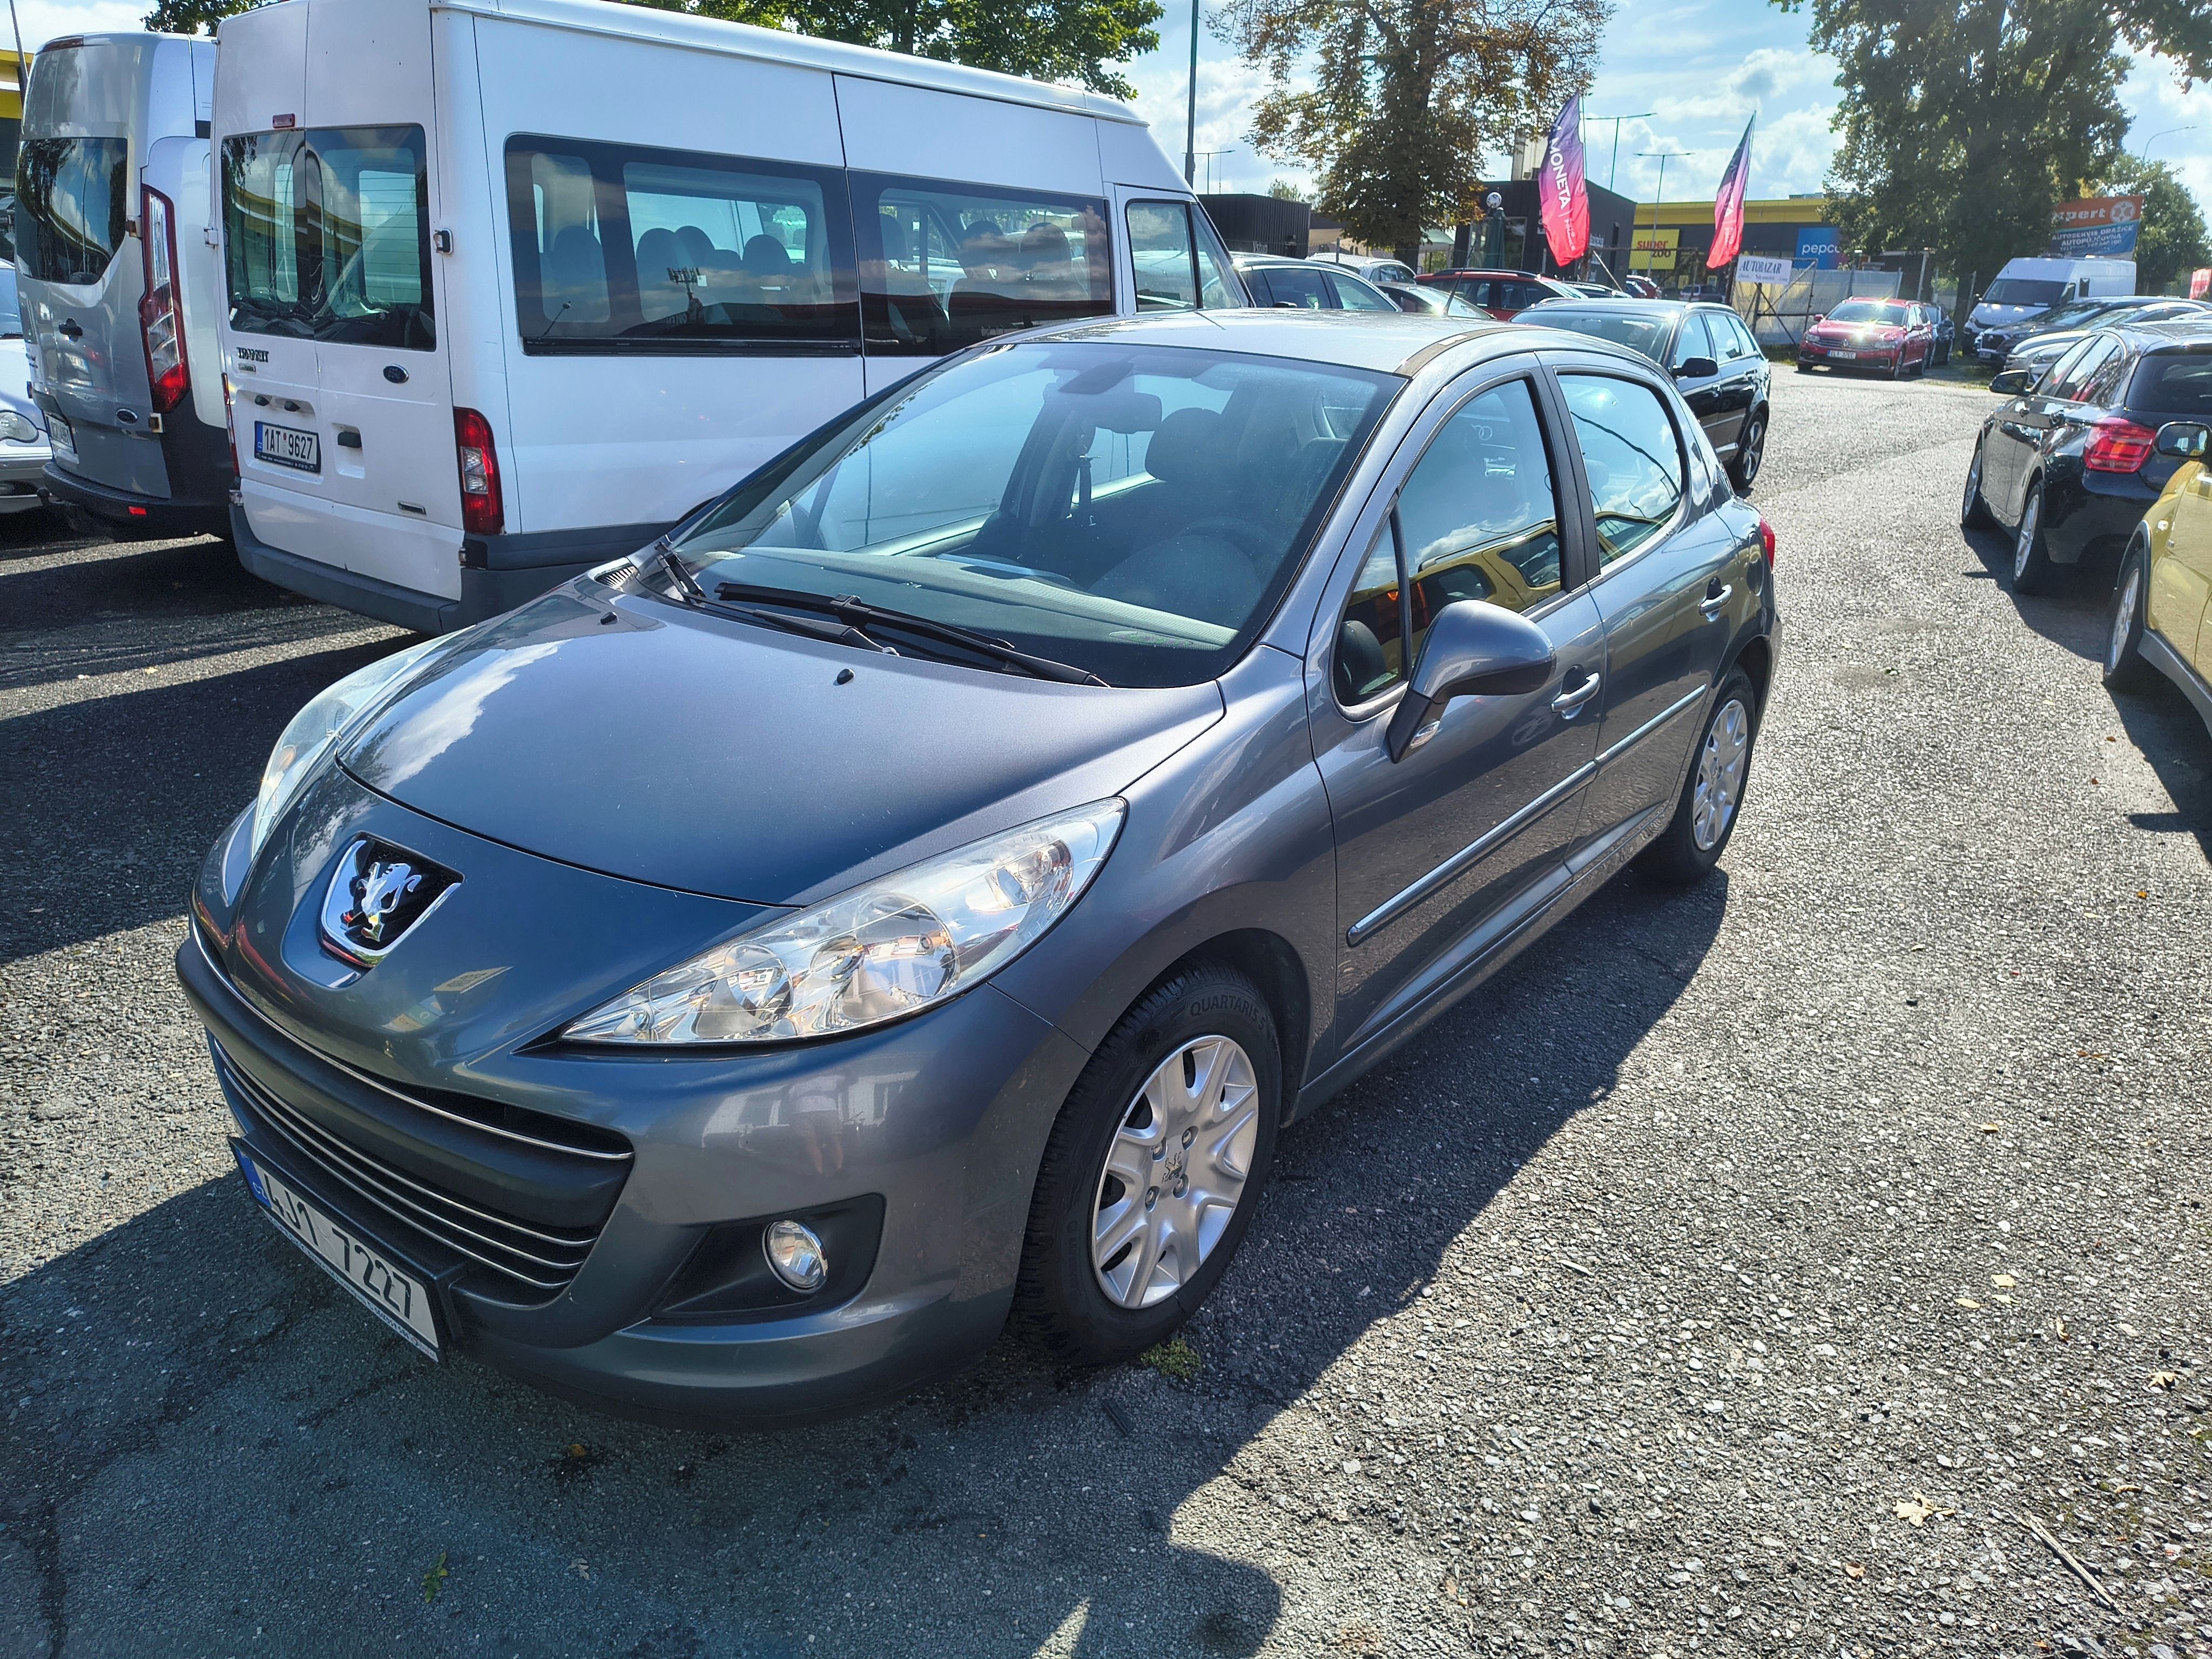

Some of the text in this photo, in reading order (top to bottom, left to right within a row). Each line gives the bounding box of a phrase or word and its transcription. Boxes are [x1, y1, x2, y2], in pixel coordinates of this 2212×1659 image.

[1549, 138, 1571, 210] MONETA
[2053, 208, 2106, 221] xpert
[1740, 260, 1782, 274] AUTOBAZAR
[265, 428, 313, 460] 1AT 9627
[1190, 995, 1259, 1022] QUARTARIS
[252, 1181, 268, 1200] CZ
[264, 1174, 319, 1246] 4J1
[332, 1226, 412, 1320] 7227
